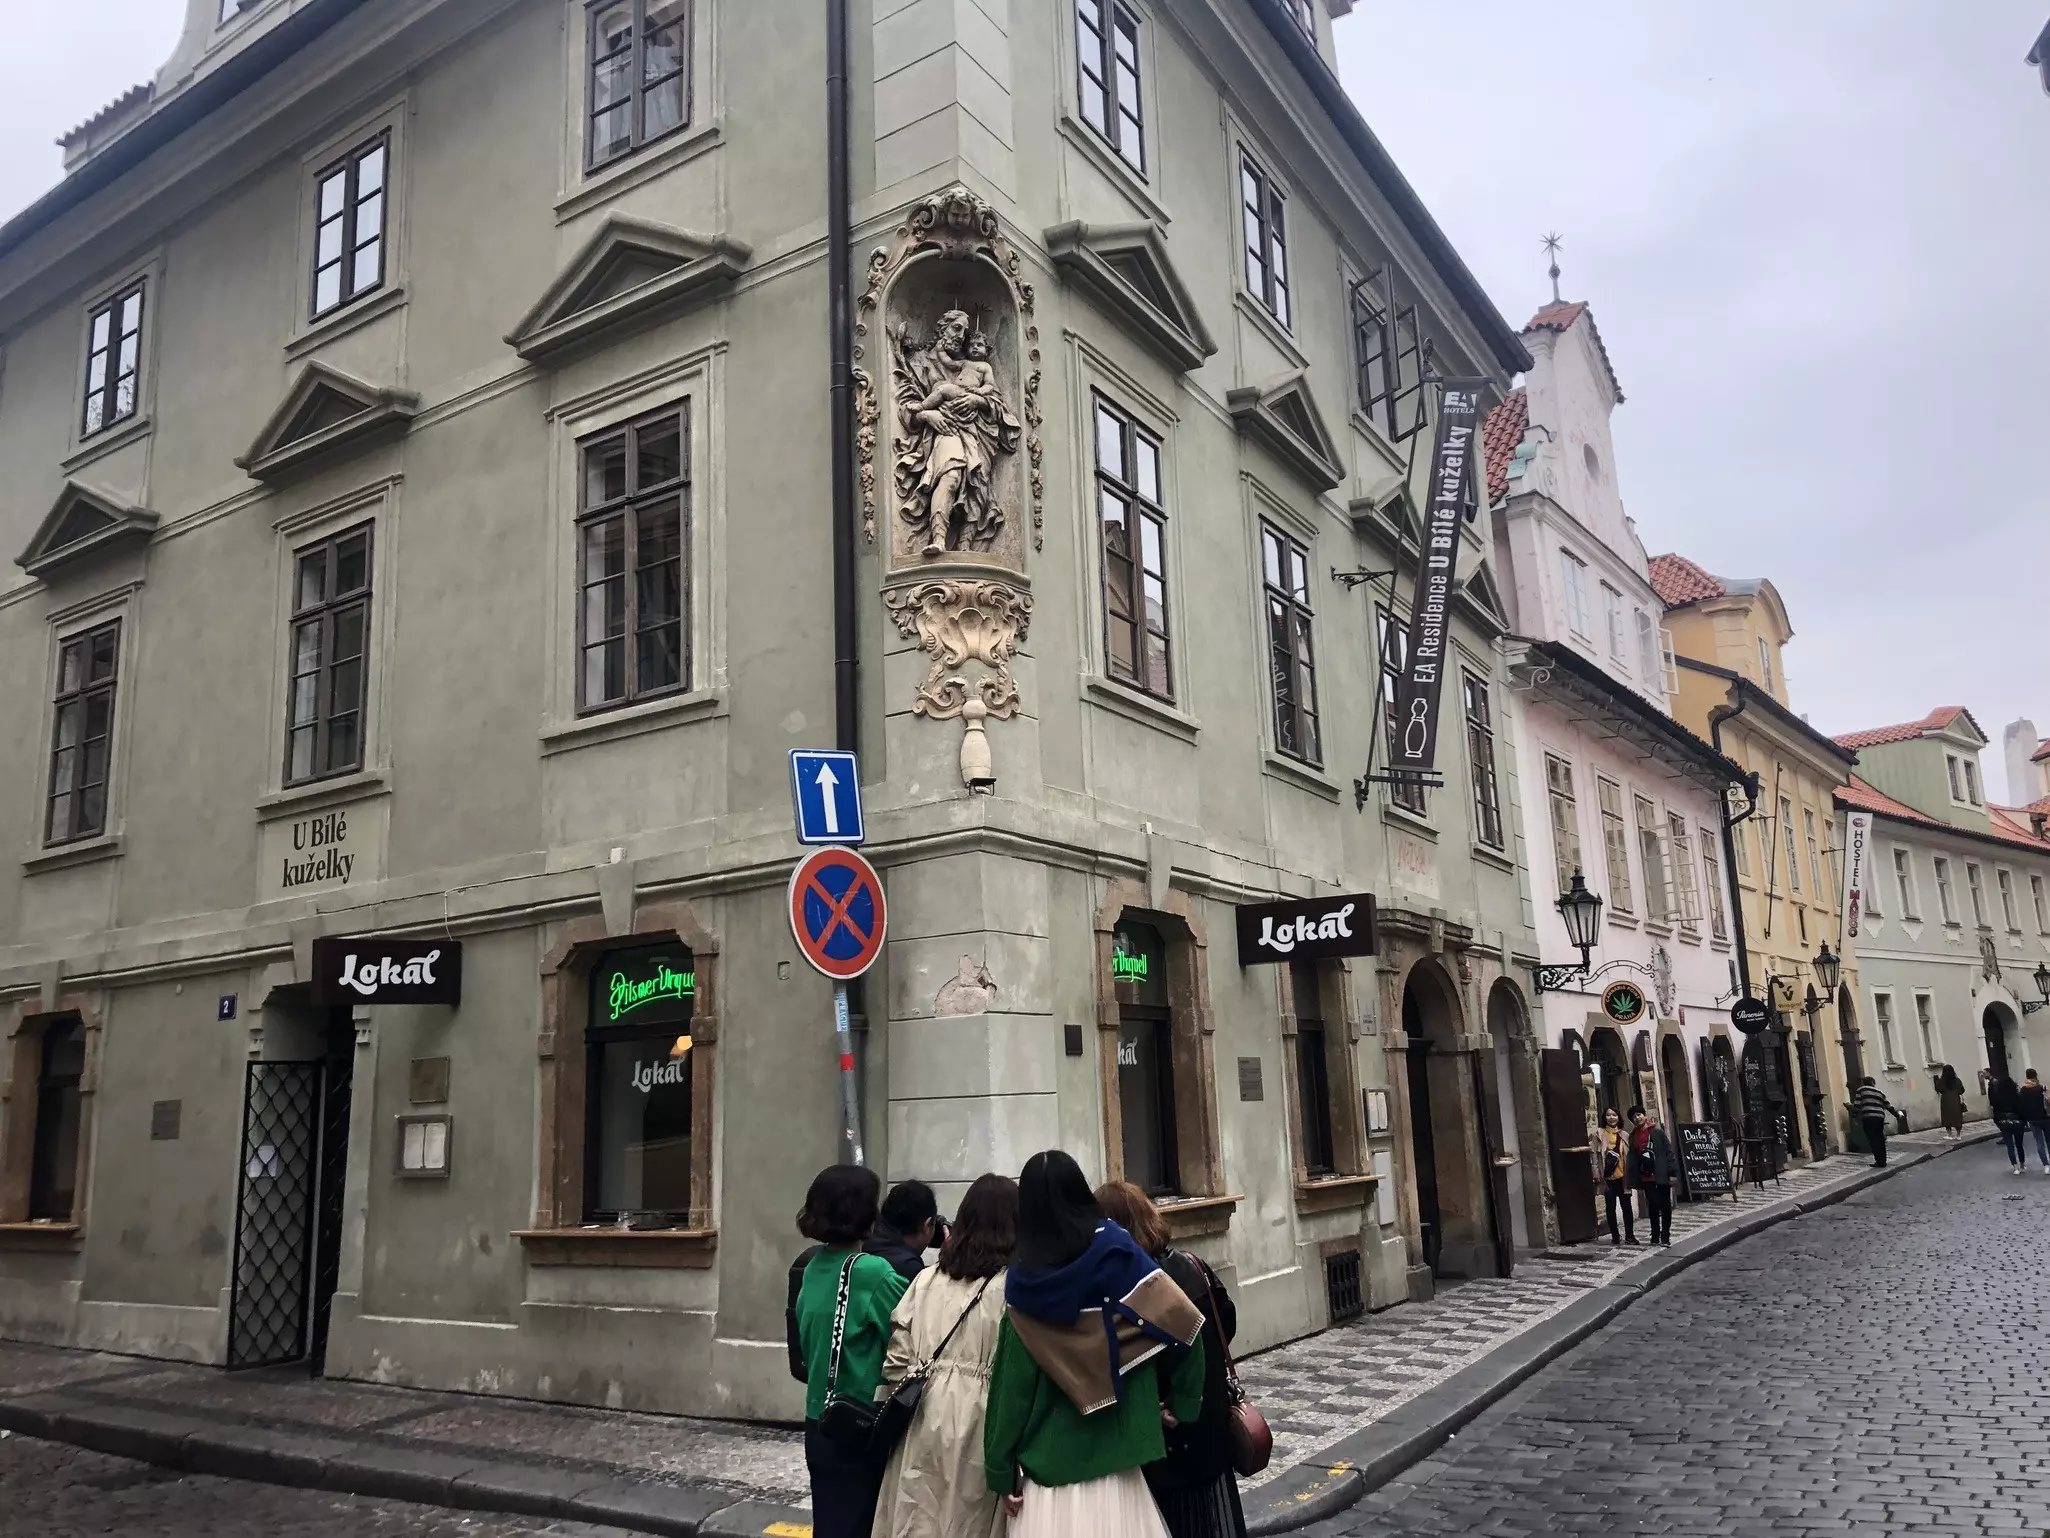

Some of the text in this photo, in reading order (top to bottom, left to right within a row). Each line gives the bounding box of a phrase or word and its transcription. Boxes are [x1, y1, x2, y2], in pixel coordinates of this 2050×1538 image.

[1413, 425, 1473, 683] EA Residence U Bílé kuželky
[293, 811, 347, 851] U Bílé
[282, 848, 355, 888] kuželky
[1852, 830, 1863, 887] HOSTEL
[223, 1000, 229, 1014] 2
[1684, 1128, 1707, 1142] Daily
